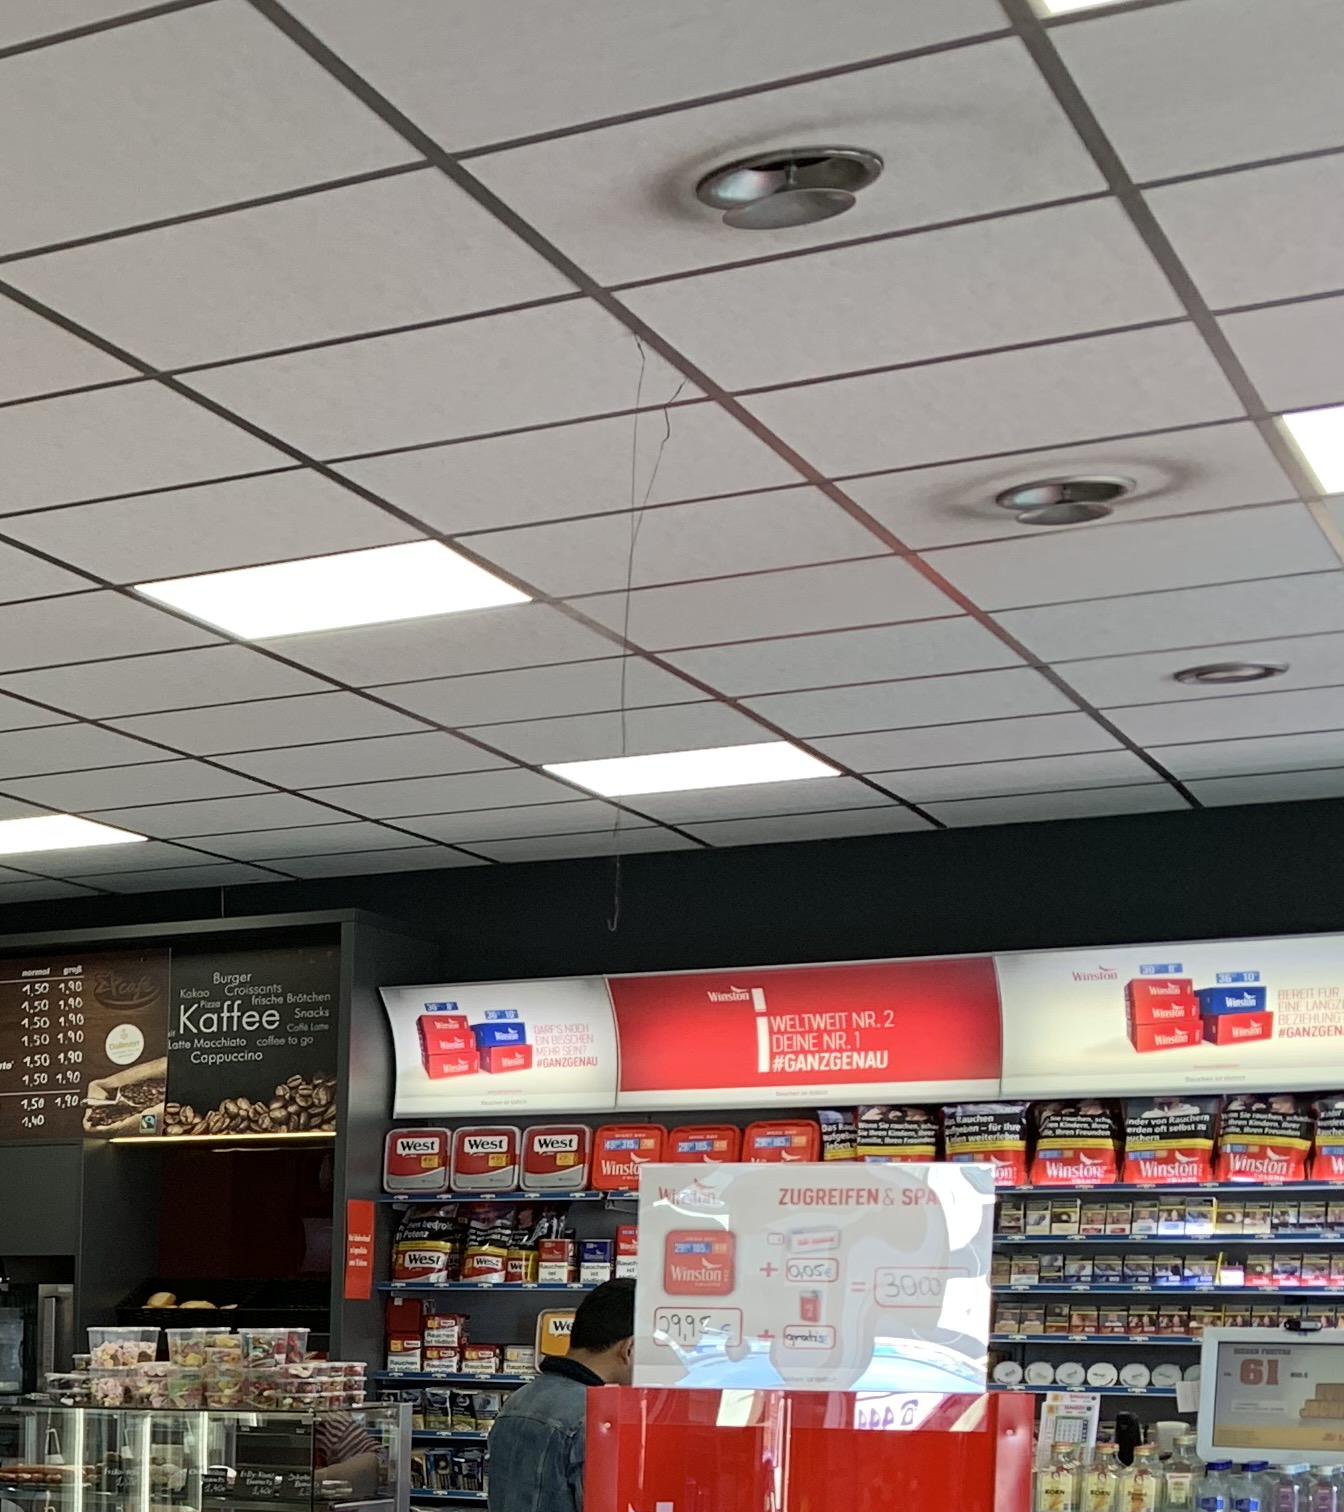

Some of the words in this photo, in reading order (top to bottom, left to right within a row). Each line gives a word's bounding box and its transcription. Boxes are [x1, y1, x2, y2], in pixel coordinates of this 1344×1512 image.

[22, 968, 50, 977] normal
[64, 965, 82, 975] groß
[213, 972, 252, 985] Burger
[180, 989, 209, 998] Kakao
[225, 984, 282, 996] Croissants
[1278, 988, 1314, 1000] BEREIT
[200, 1000, 220, 1008] Pizza
[252, 995, 284, 1005] frische
[287, 992, 331, 1003] Brötchen
[179, 1000, 280, 1034] Kaffee
[294, 1007, 330, 1018] Snacks
[770, 1012, 847, 1031] WELTWEIT
[852, 1011, 881, 1028] NR.
[883, 1009, 895, 1027] 2
[310, 1023, 329, 1031] Latte
[534, 1025, 562, 1034] DARF'S
[564, 1024, 589, 1033] NOCH
[194, 1038, 247, 1048] Macchiato
[256, 1036, 285, 1046] coffee
[288, 1036, 297, 1045] to
[300, 1036, 313, 1046] go
[536, 1035, 549, 1045] EIN
[552, 1034, 593, 1044] BISSCHEN
[772, 1034, 819, 1052] DEINE
[823, 1032, 853, 1050] NR.
[855, 1031, 861, 1048] 1
[536, 1047, 560, 1056] MEHR
[562, 1046, 587, 1055] SEIN?
[191, 1051, 263, 1065] Cappuccino
[536, 1056, 598, 1068] #GANZGENAU
[772, 1049, 889, 1073] #GANZGENAU
[956, 1115, 994, 1123] Rauchen
[400, 1140, 436, 1152] West
[468, 1138, 504, 1150] West
[536, 1137, 574, 1149] West
[1140, 1161, 1198, 1177] Winston
[1230, 1153, 1287, 1173] Winston
[778, 1188, 878, 1206] ZUGREIFEN
[883, 1188, 895, 1205] &
[902, 1187, 935, 1206] SPA
[670, 1265, 721, 1282] Winston
